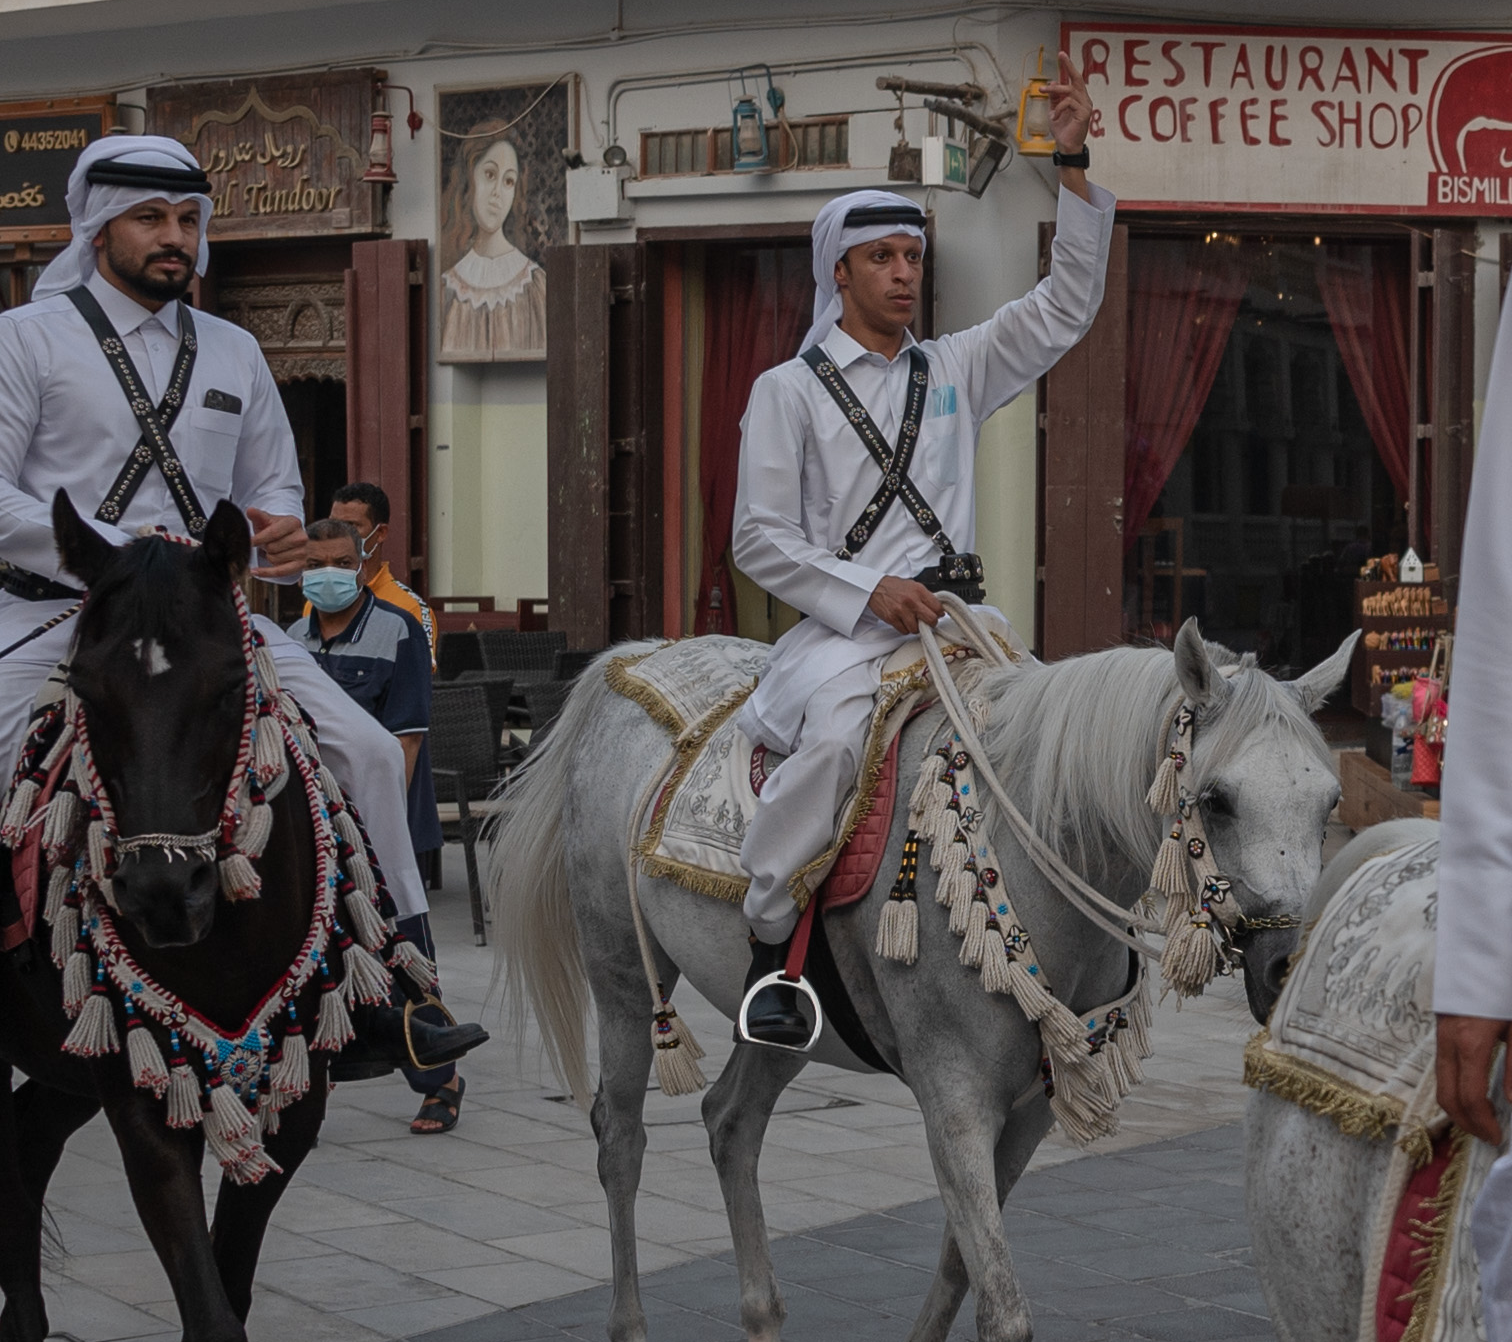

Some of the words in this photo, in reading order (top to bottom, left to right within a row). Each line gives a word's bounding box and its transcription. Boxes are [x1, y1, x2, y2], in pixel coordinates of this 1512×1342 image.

[1081, 38, 1430, 96] RESTAURANT
[21, 129, 88, 151] 44352041
[1088, 109, 1106, 139] &
[1118, 94, 1292, 147] COFFEE
[1311, 100, 1423, 150] SHOP
[243, 175, 342, 216] Tandoor
